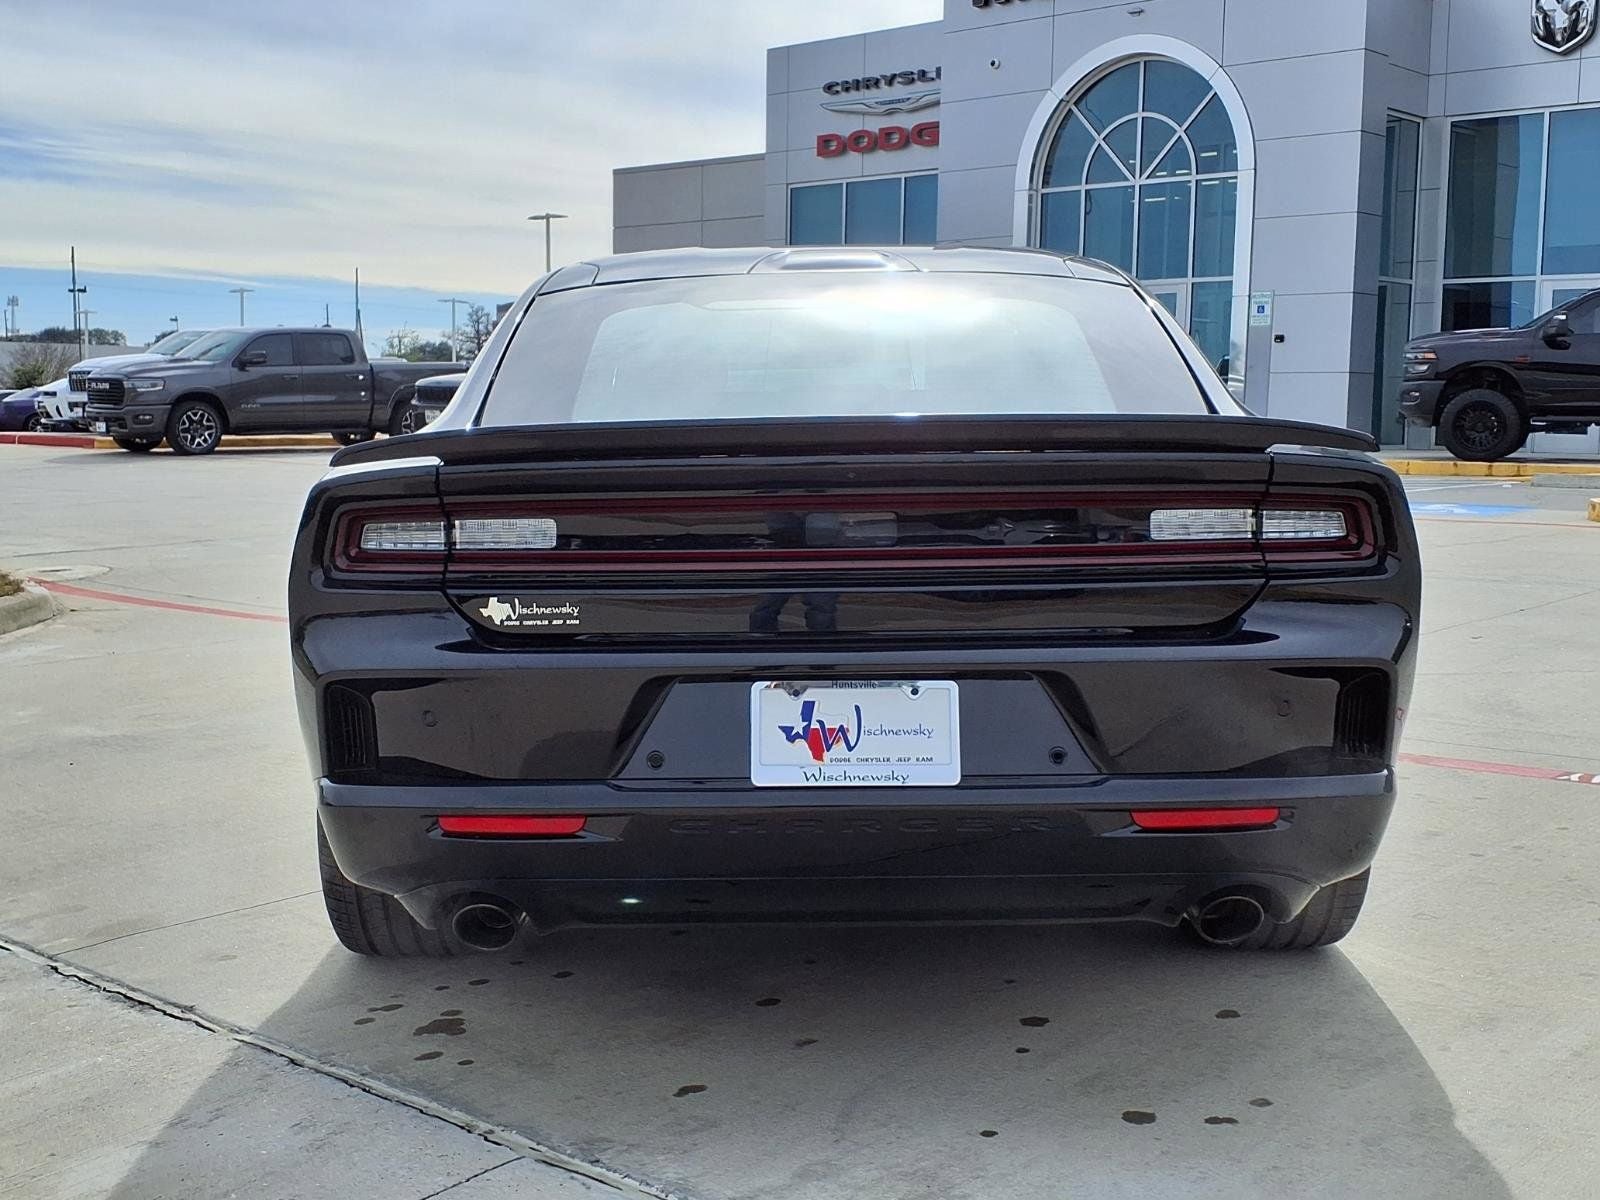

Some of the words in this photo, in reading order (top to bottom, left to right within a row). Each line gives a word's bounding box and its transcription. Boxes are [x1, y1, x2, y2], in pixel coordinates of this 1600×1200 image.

[816, 121, 939, 158] DODG
[831, 680, 878, 689] Huntsville
[816, 704, 934, 753] Wischnewsky
[803, 767, 910, 784] Wischnewsky
